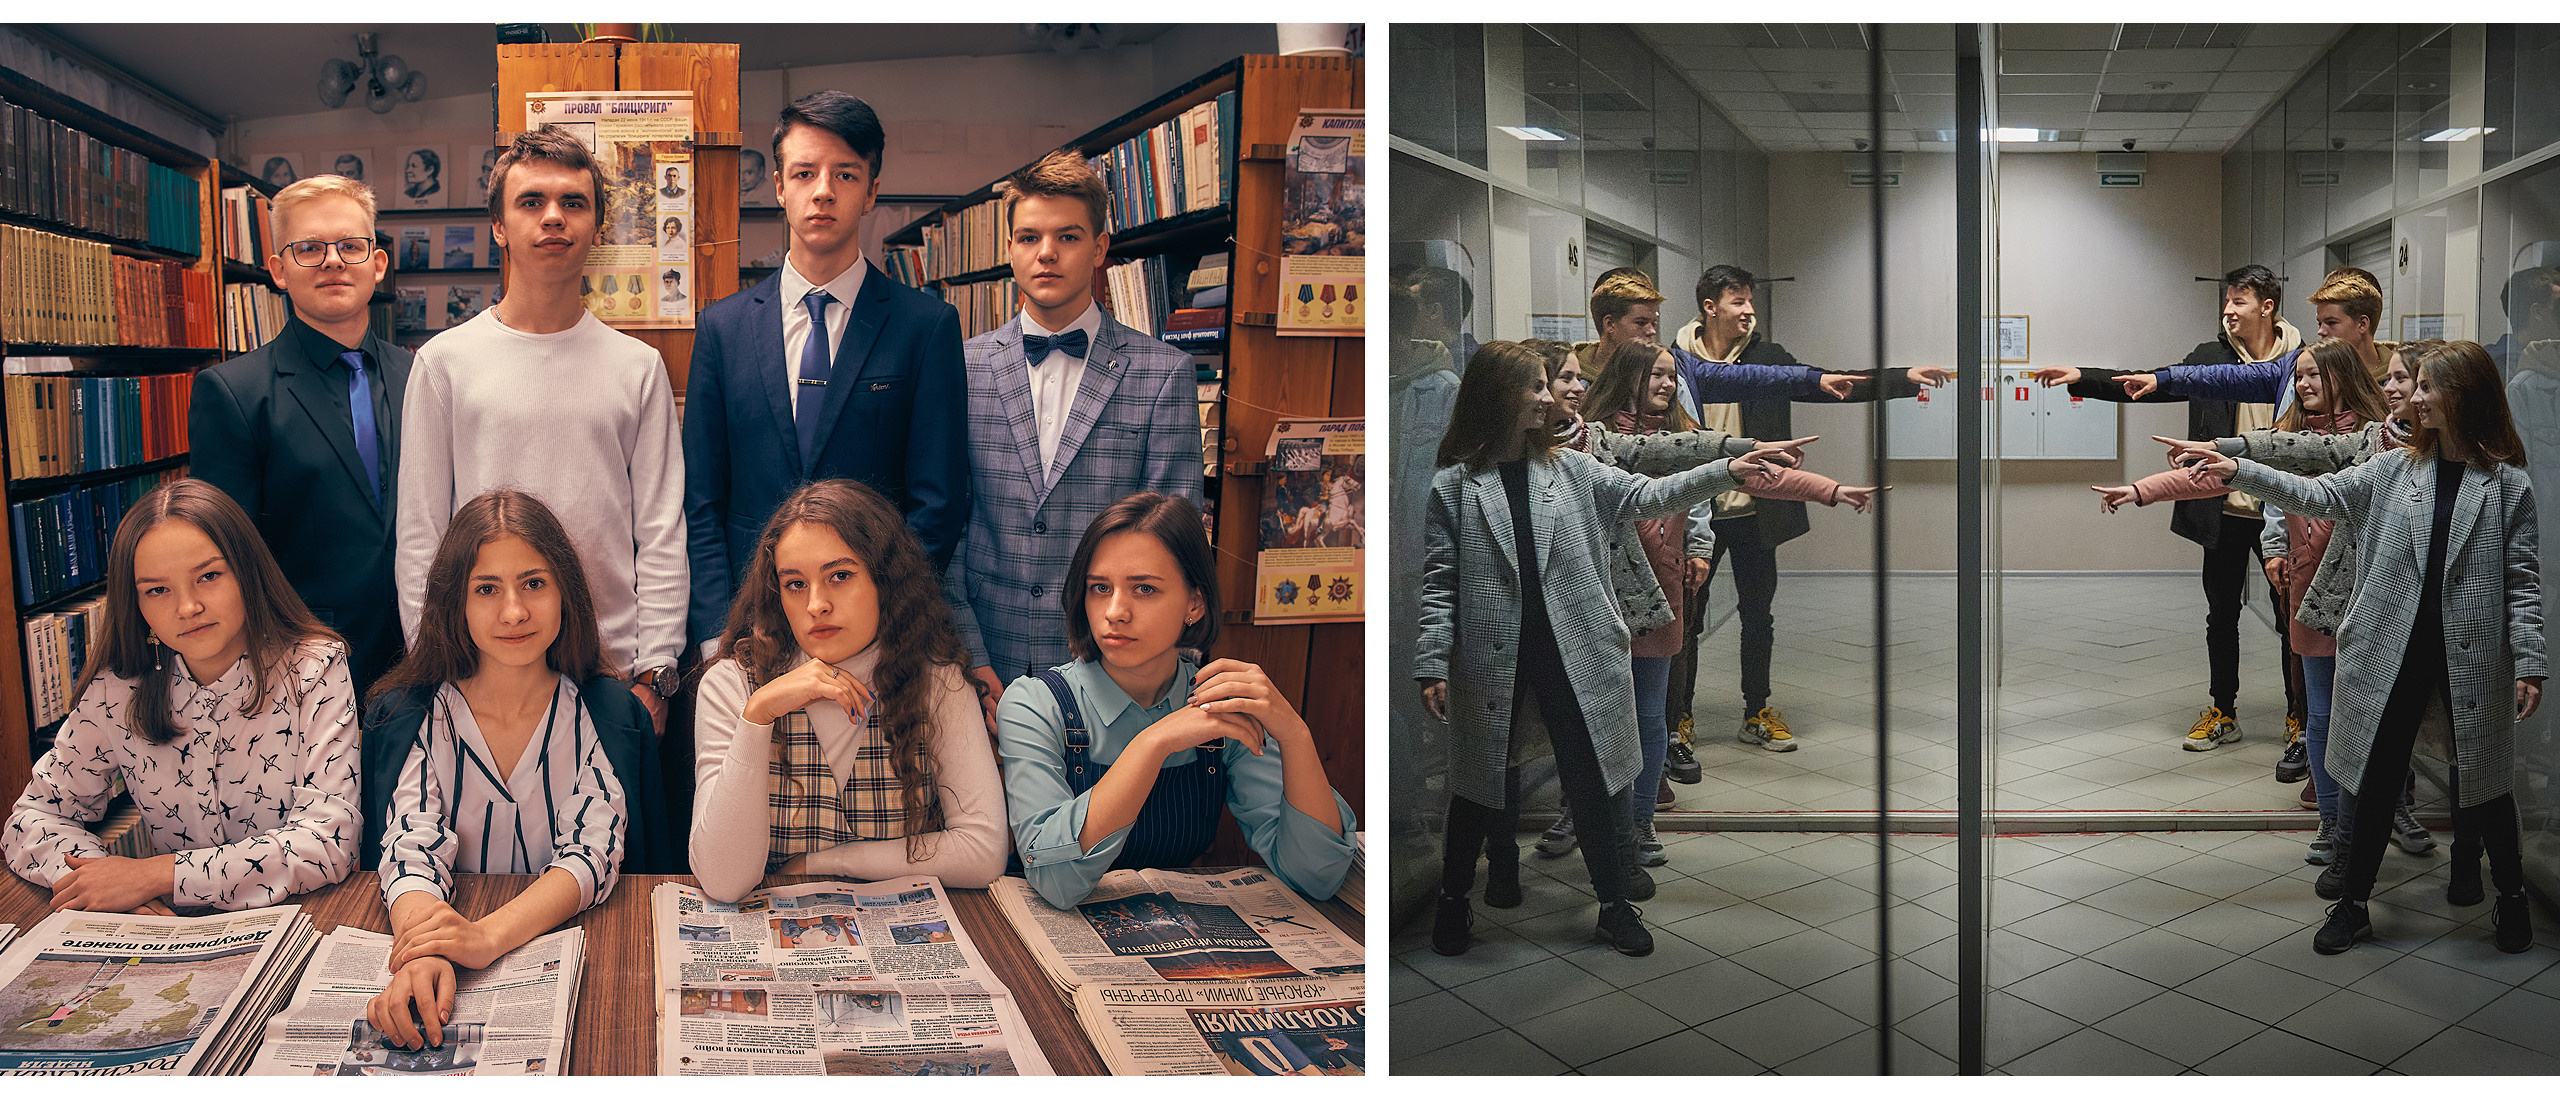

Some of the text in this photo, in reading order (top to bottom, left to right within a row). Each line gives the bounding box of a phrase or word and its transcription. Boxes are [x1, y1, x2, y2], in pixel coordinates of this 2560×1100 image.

[565, 102, 672, 115] ПРОВАЛ "БЛИЦКРИГА"
[2399, 244, 2408, 266] 24
[1319, 424, 1347, 432] ПАРАД
[62, 930, 272, 952] Дежурный по планете
[1117, 937, 1266, 954] МАЙДАН ИНДЕПЕНДЕНТА
[1100, 983, 1326, 1002] «КРАСНЫЕ ЛИНИИ» ПРОЧЕРЧЕНЫ
[1193, 1007, 1356, 1033] КОАЛИЦИЯ!
[734, 1046, 774, 1054] ДЛИНОЮ
[18, 1060, 95, 1068] НЕДЕЛЯ
